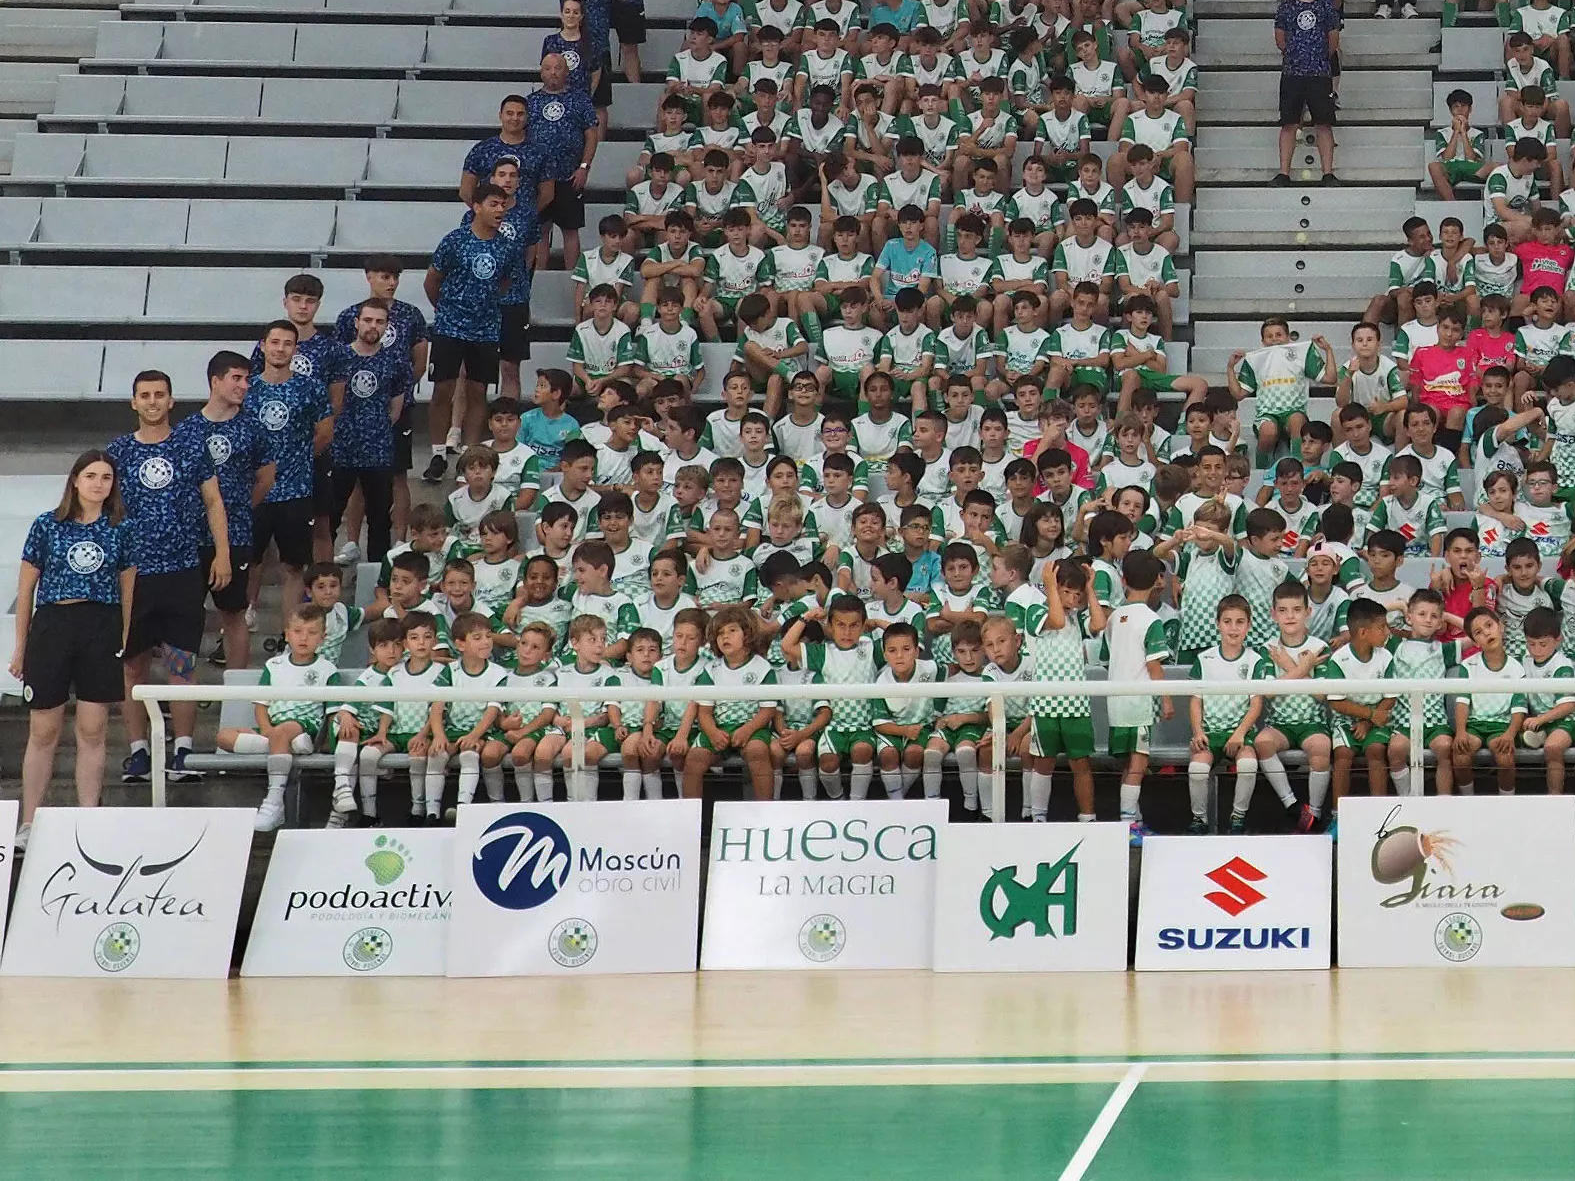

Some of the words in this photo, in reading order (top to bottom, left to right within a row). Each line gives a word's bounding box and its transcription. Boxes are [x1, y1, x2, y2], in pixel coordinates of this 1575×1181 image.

[579, 845, 681, 873] Mascún
[40, 854, 206, 934] Galatea
[578, 874, 634, 894] obra
[642, 874, 682, 893] civil
[283, 883, 453, 921] podoactiv
[1157, 926, 1311, 951] SUZUKI
